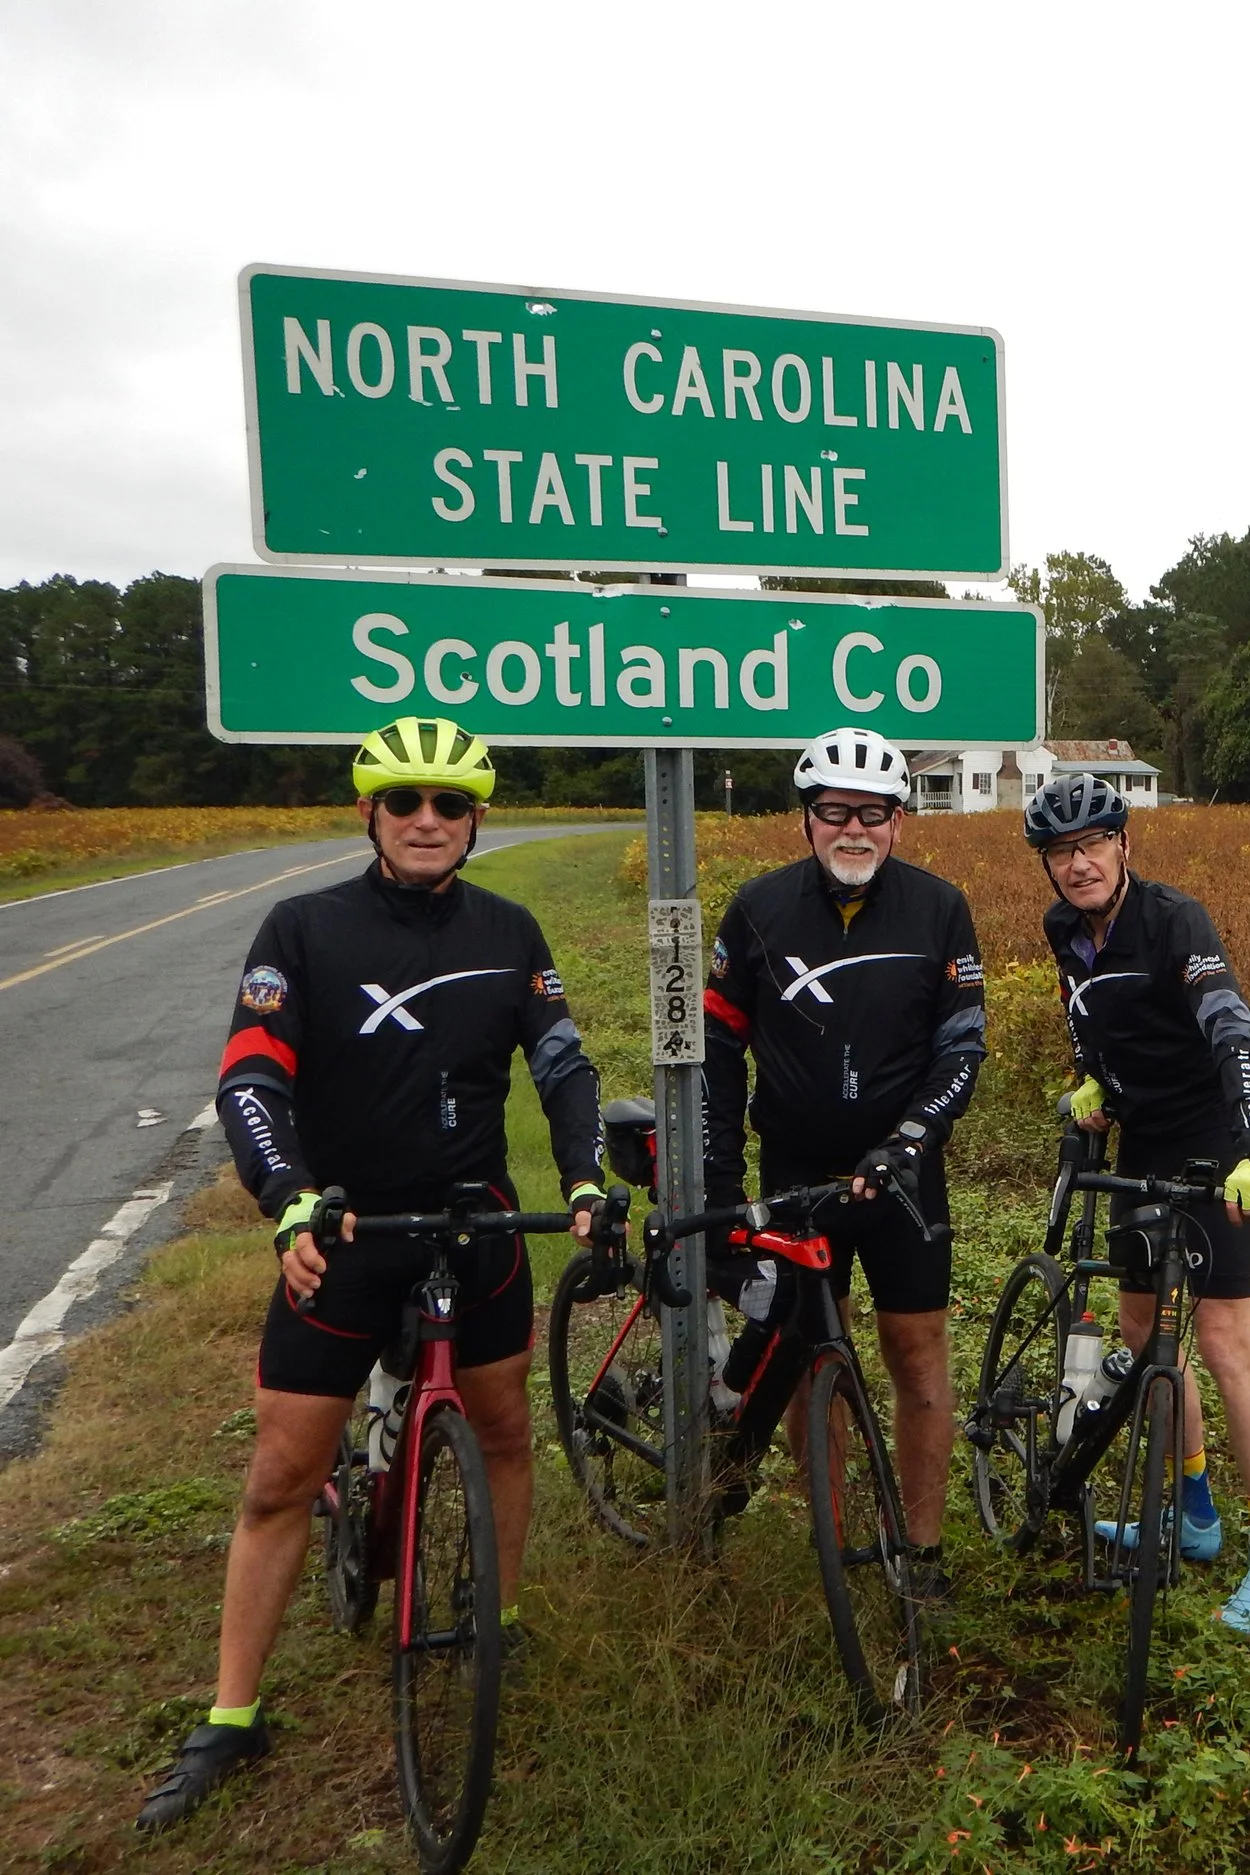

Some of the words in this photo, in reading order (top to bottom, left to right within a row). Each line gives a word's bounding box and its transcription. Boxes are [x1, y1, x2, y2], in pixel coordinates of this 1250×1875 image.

[283, 317, 558, 408] NORTH
[623, 342, 973, 434] CAROLINA
[432, 447, 663, 528] STATE
[716, 461, 870, 536] LINE
[350, 613, 790, 711] Scotland
[832, 631, 943, 713] Co
[447, 1097, 457, 1127] CURE
[849, 1070, 858, 1099] CURE
